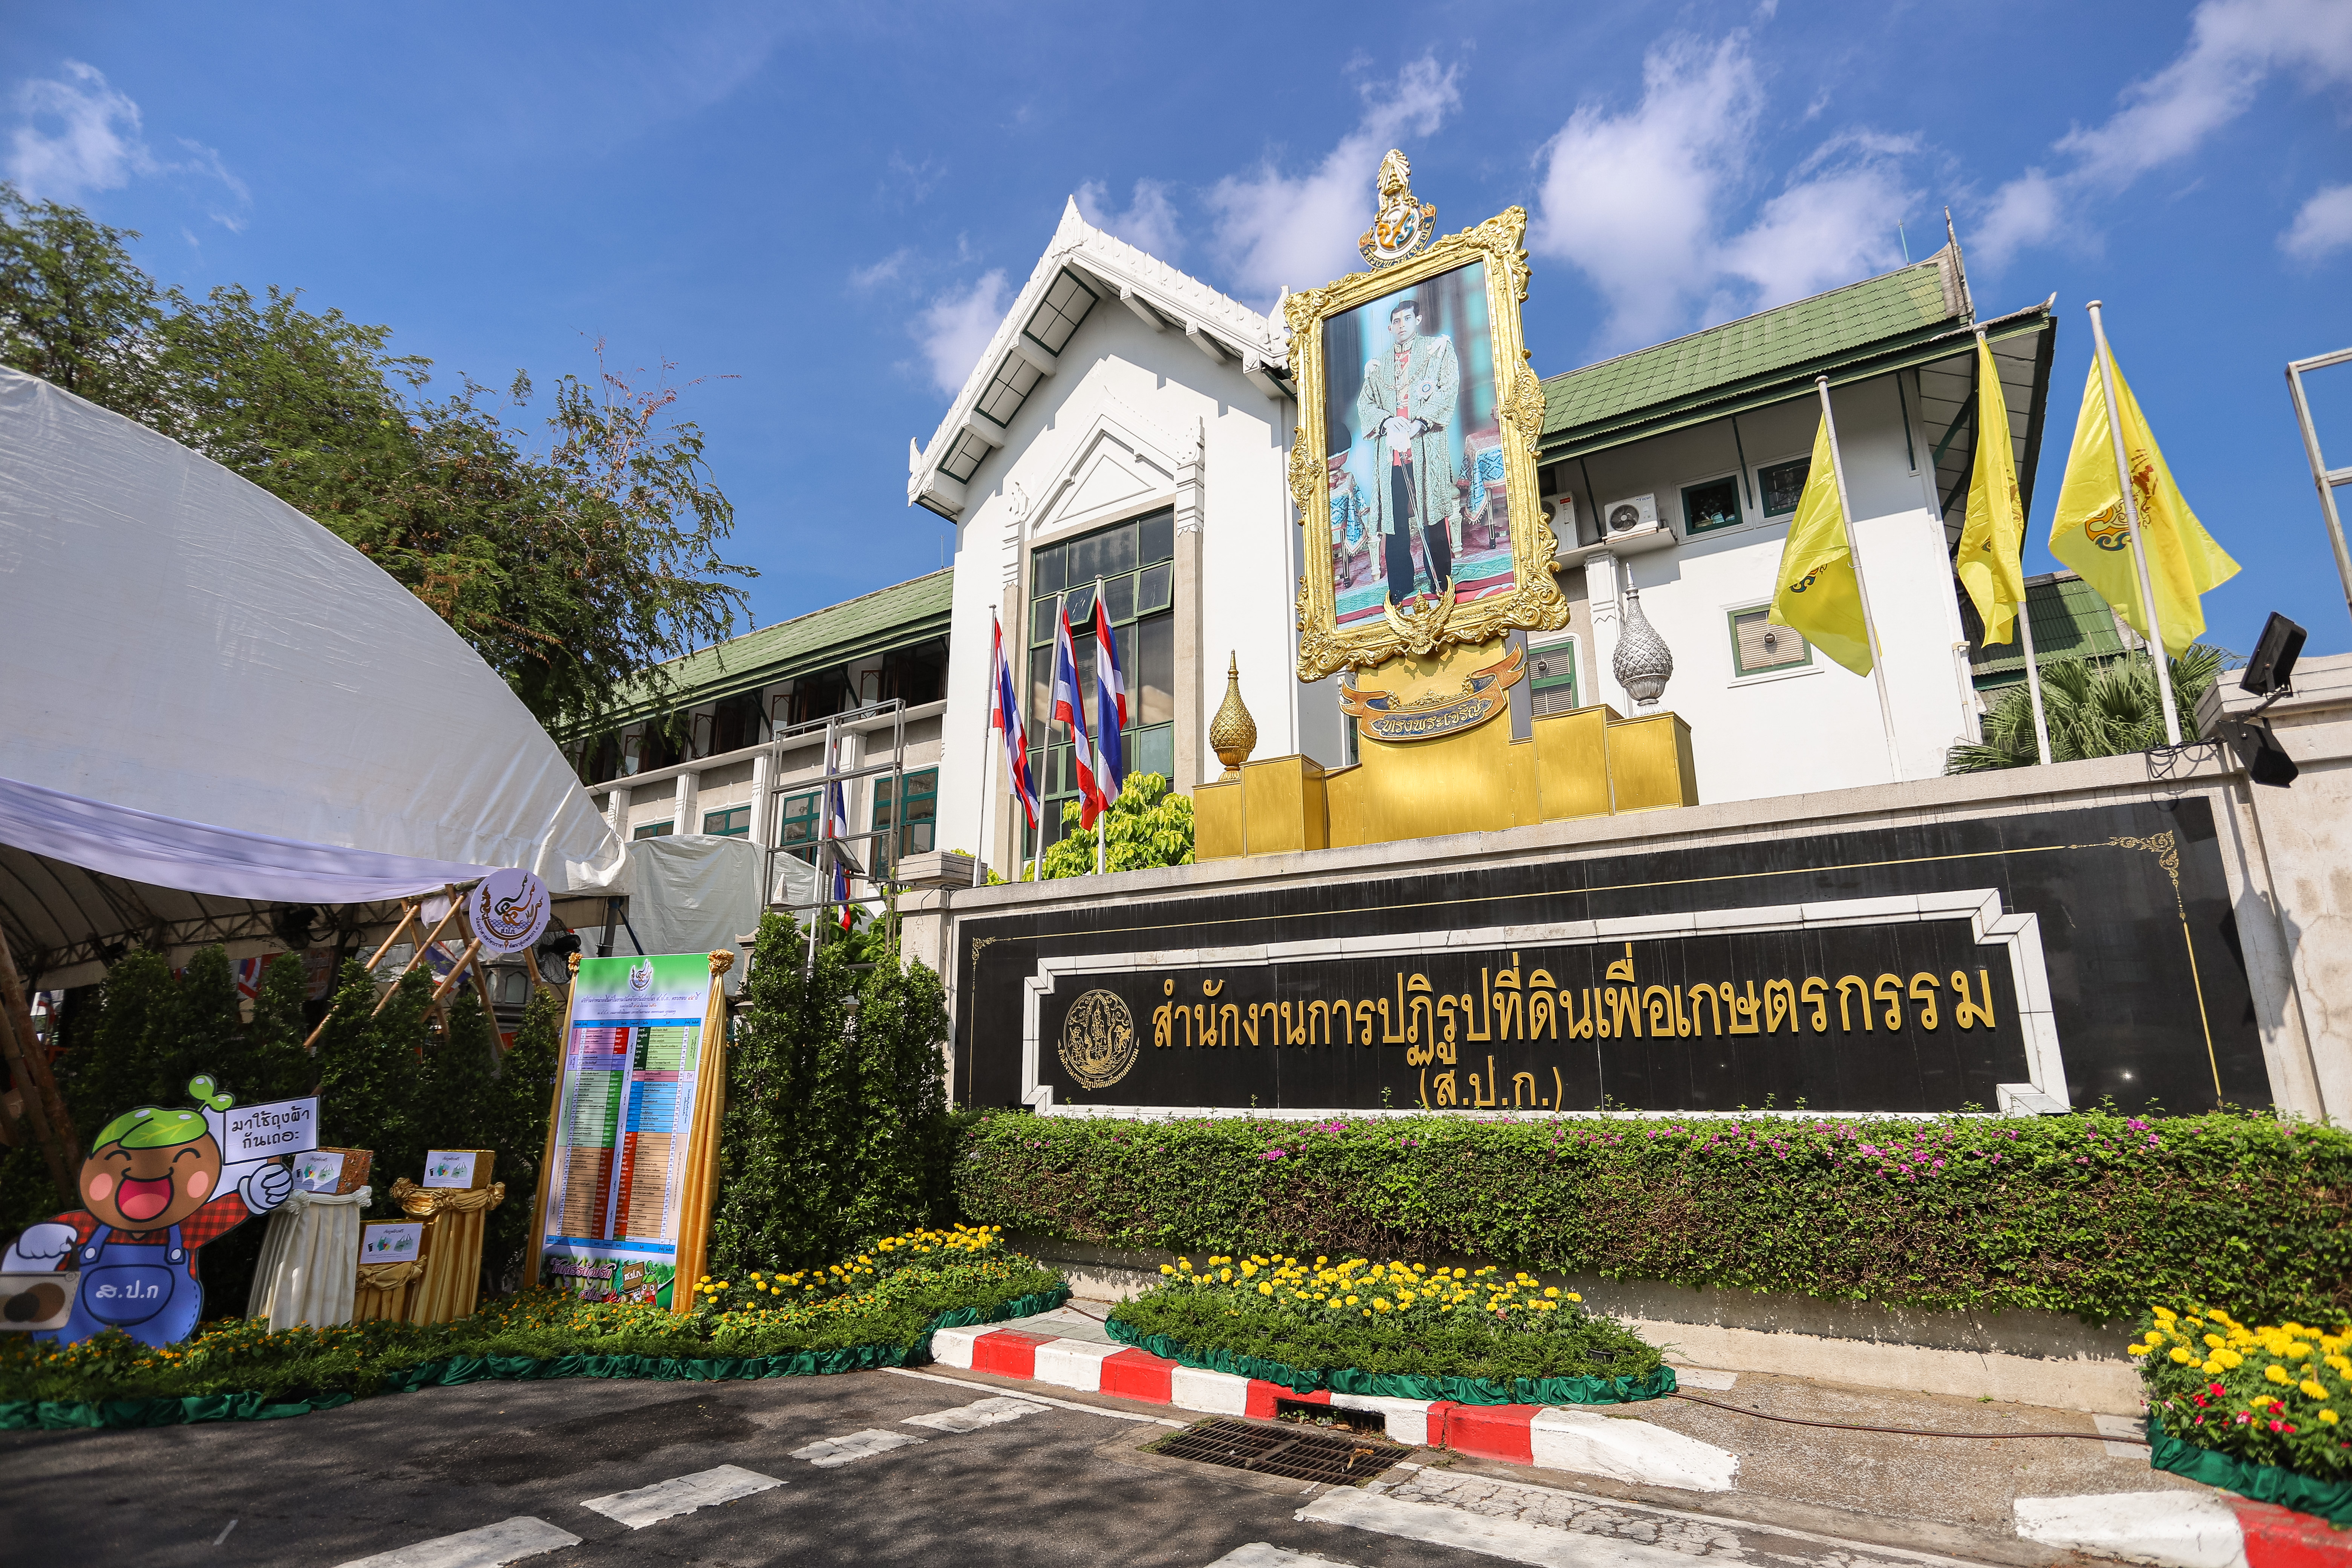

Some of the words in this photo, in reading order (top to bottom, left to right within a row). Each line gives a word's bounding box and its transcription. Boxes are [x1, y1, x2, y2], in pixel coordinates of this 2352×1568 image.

[1382, 703, 1482, 733] ทรงพระเจริญ
[501, 926, 516, 934] ส.ป.ก.
[1152, 942, 1997, 1067] สำนักงานการปฏิรูปที่ดินเพื่อเกษตรกรรม
[1057, 1048, 1139, 1091] สำนักงานการปฏิรูปที่ดินเพื่อเกษตรกรรม
[1419, 1055, 1563, 1112] (ส.ป.ก.)
[232, 1106, 310, 1130] มาใช้ถุงผ้า
[242, 1131, 299, 1149] กันเถอะ
[624, 1269, 643, 1281] ส.ป.ก.
[95, 1280, 159, 1298] ส.ป.ก
